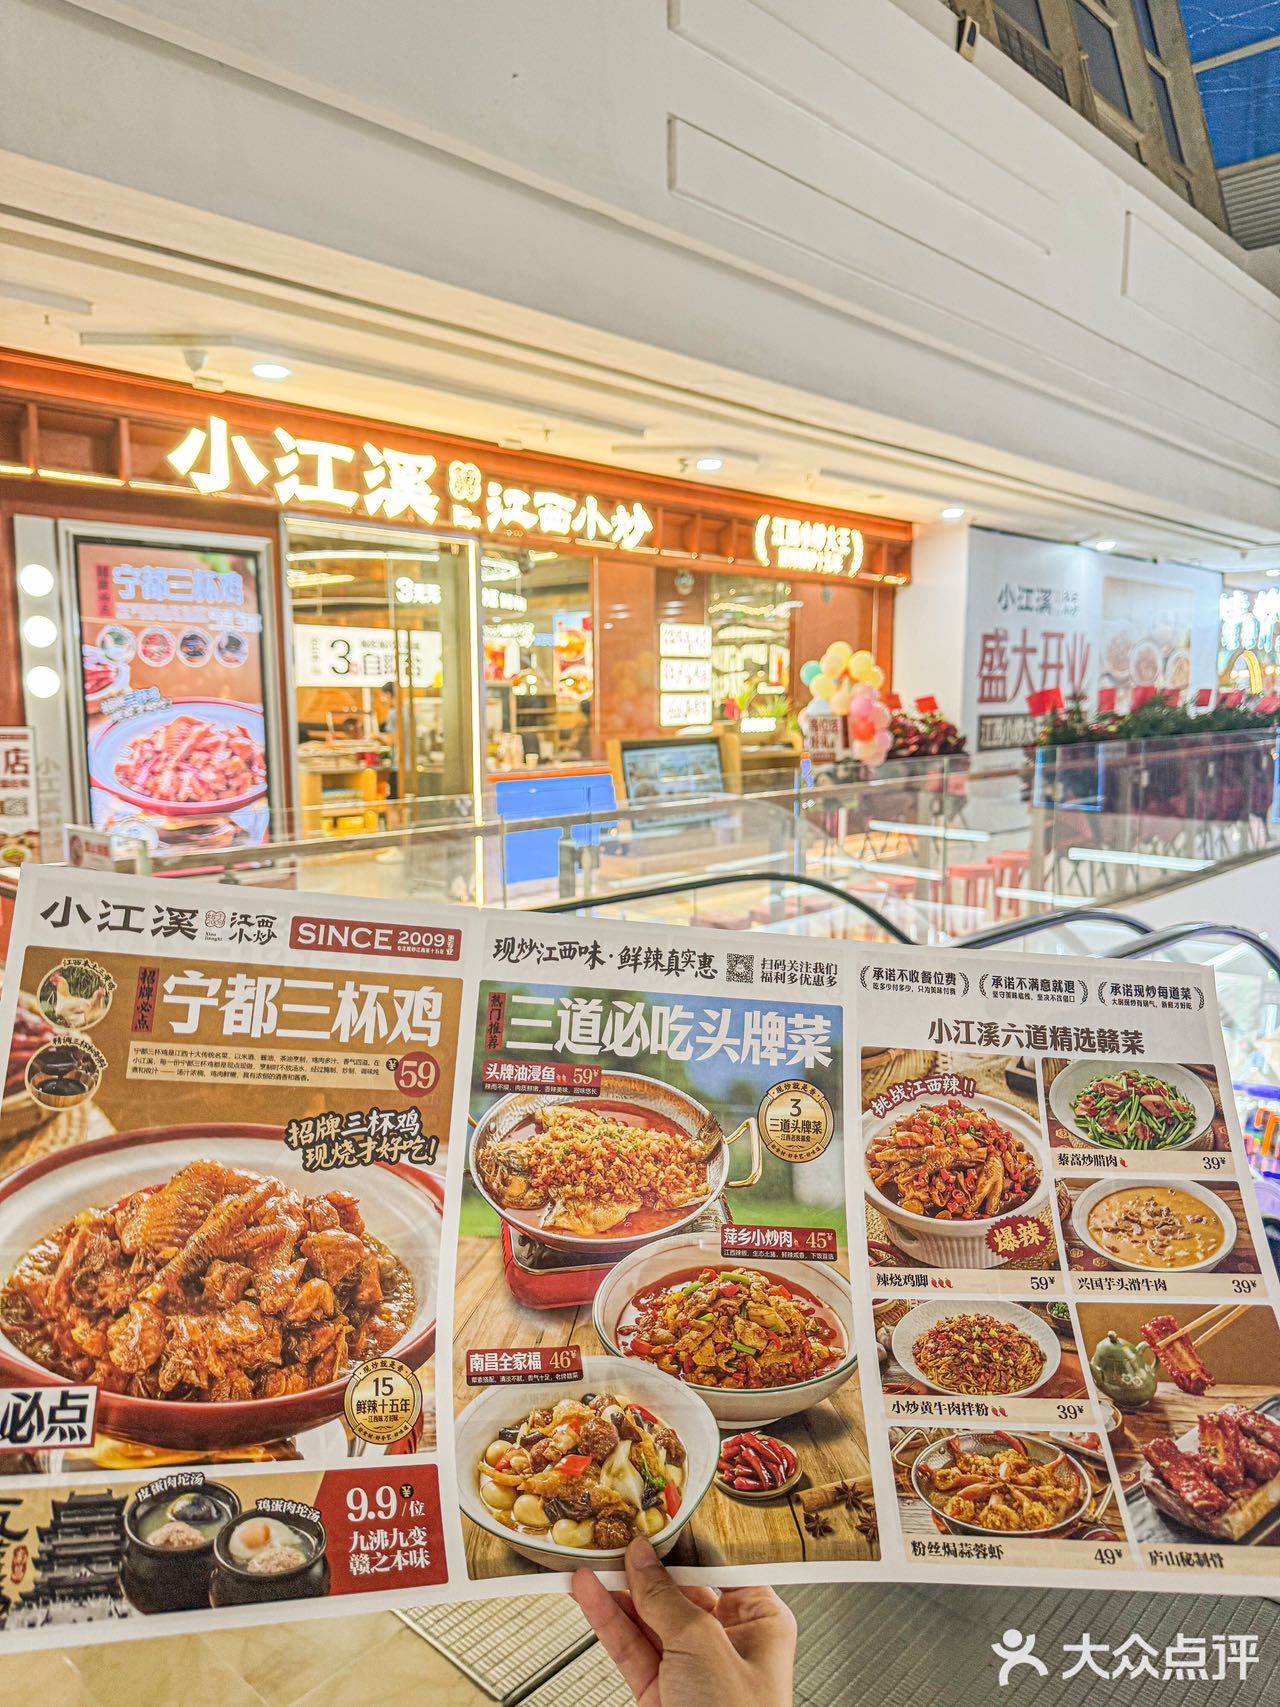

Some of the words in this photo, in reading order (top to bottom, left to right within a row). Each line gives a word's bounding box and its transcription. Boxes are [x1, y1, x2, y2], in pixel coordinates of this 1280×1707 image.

[167, 415, 440, 527] 小江溪
[485, 482, 654, 550] 江西小炒
[978, 626, 1091, 703] 盛大开业
[40, 896, 199, 941] 小江溪
[230, 912, 278, 928] 江西
[229, 927, 278, 945] 小炒
[297, 922, 393, 950] SINCE
[398, 930, 445, 947] 2009
[492, 936, 719, 979] 现炒江西味·鲜辣真实惠
[760, 957, 838, 976] 扫码关注我们
[760, 971, 838, 988] 福利多优惠多
[872, 966, 957, 986] 承诺不收餐位费
[991, 975, 1075, 994] 承诺不满意就退
[135, 968, 157, 1031] 招牌必点
[1110, 982, 1192, 1000] 承诺现炒每道菜
[162, 970, 444, 1048] 宁都三杯鸡
[488, 994, 503, 1050] 热门推荐
[506, 995, 834, 1070] 三道必吃头牌菜
[928, 1018, 1146, 1056] 小江溪六道精选赣菜
[399, 1060, 436, 1089] 59
[486, 1063, 556, 1083] 头牌油浸鱼
[790, 1098, 802, 1117] 3
[287, 1108, 421, 1145] 招牌三杯鸡
[769, 1118, 823, 1134] 三道头牌菜
[723, 1227, 793, 1247] 萍乡小炒肉
[994, 1220, 1046, 1257] 爆辣
[876, 1272, 929, 1288] 辣烧鸡脚
[1077, 1277, 1168, 1292] 兴国芋头滑牛肉
[469, 1352, 542, 1373] 南昌全家福
[373, 1377, 394, 1397] 15
[0, 1390, 90, 1444] 必点
[355, 1398, 411, 1414] 鲜辣十五年
[891, 1400, 989, 1417] 小炒黄牛肉拌粉
[346, 1485, 398, 1522] 9.9
[348, 1525, 428, 1553] 九沸九变
[349, 1547, 431, 1576] 赣之本味
